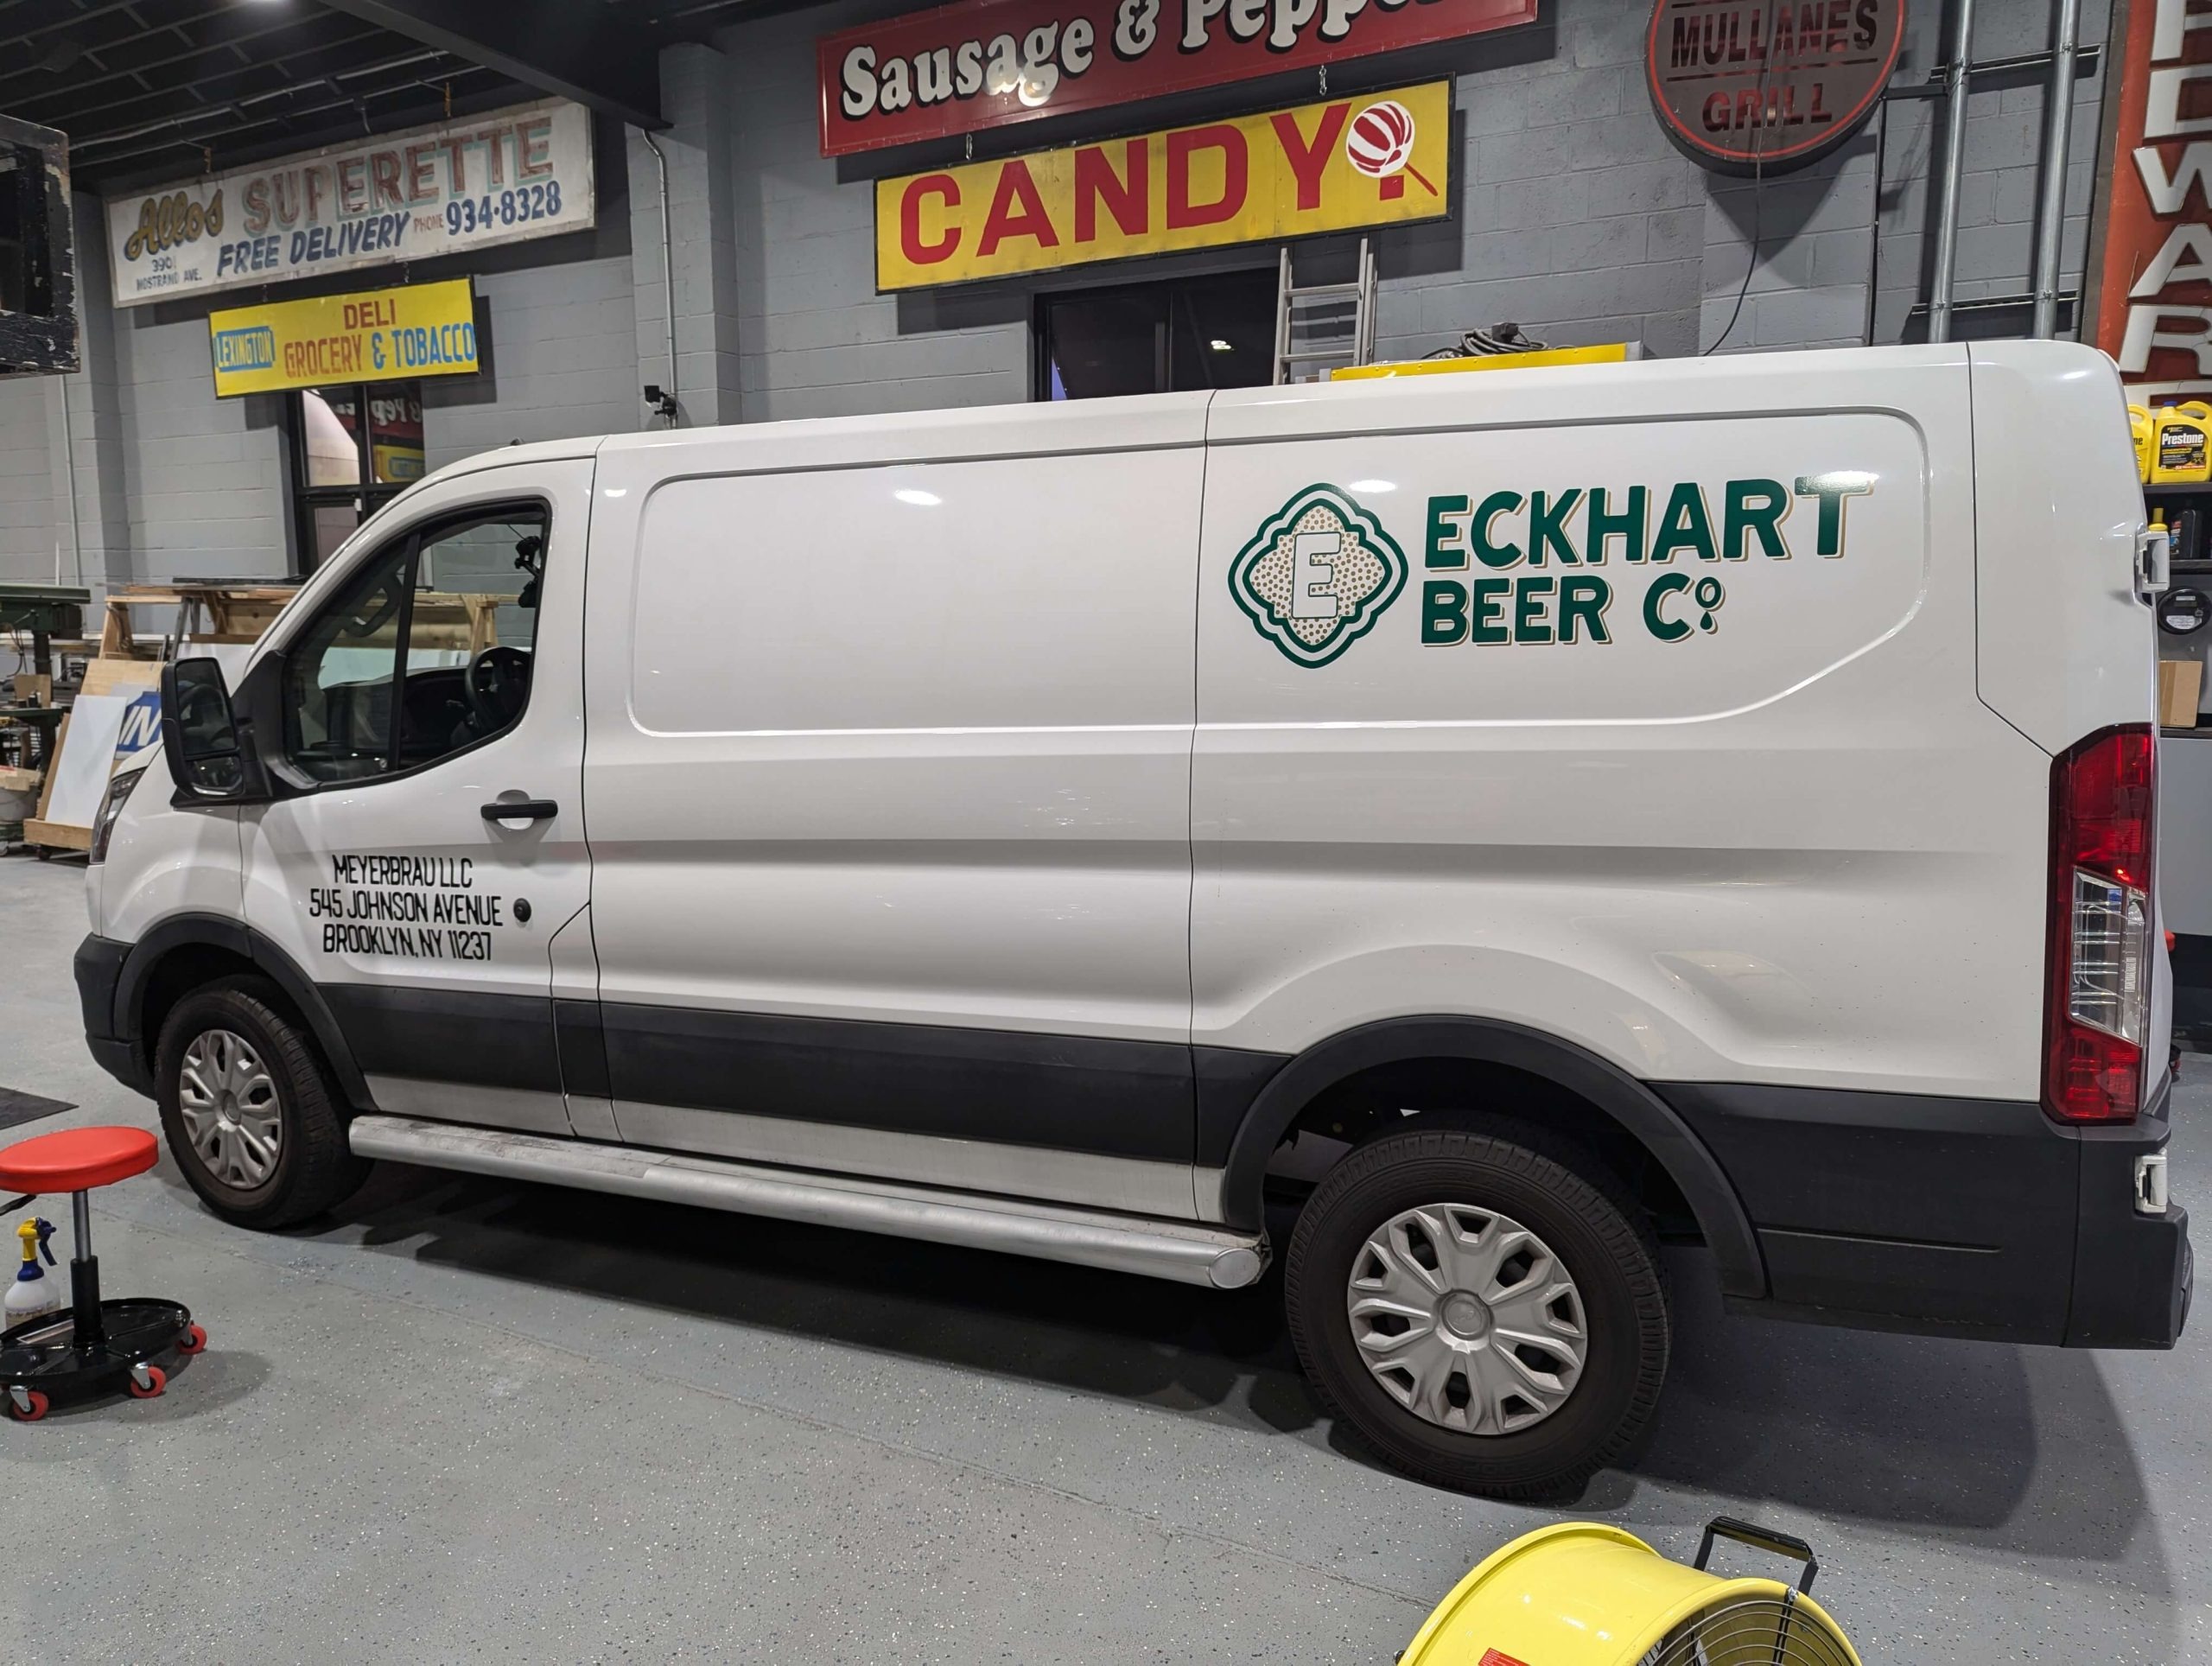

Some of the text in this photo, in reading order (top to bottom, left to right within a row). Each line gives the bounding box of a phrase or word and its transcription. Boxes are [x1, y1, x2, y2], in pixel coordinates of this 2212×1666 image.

[842, 0, 1414, 117] Sausage & Pepp
[1670, 0, 1878, 68] MULLANES
[1701, 82, 1833, 132] GRILL
[242, 116, 554, 238] SUPERETTE
[216, 234, 281, 277] FREE
[289, 210, 411, 265] DELIVERY
[413, 213, 445, 234] PHONE
[343, 298, 397, 331] DELI
[214, 327, 274, 369] LEXINGTON
[283, 322, 477, 378] GROCERY & TOBACCO
[2161, 433, 2204, 445] Prestone
[1425, 475, 1878, 570] ECKHART
[1421, 574, 1613, 647] BEER
[332, 855, 474, 888] MEYERBRAU LLC
[309, 888, 504, 926] 545 JOHNSON AVENUE
[419, 929, 442, 957] NY
[447, 930, 492, 961] 11237
